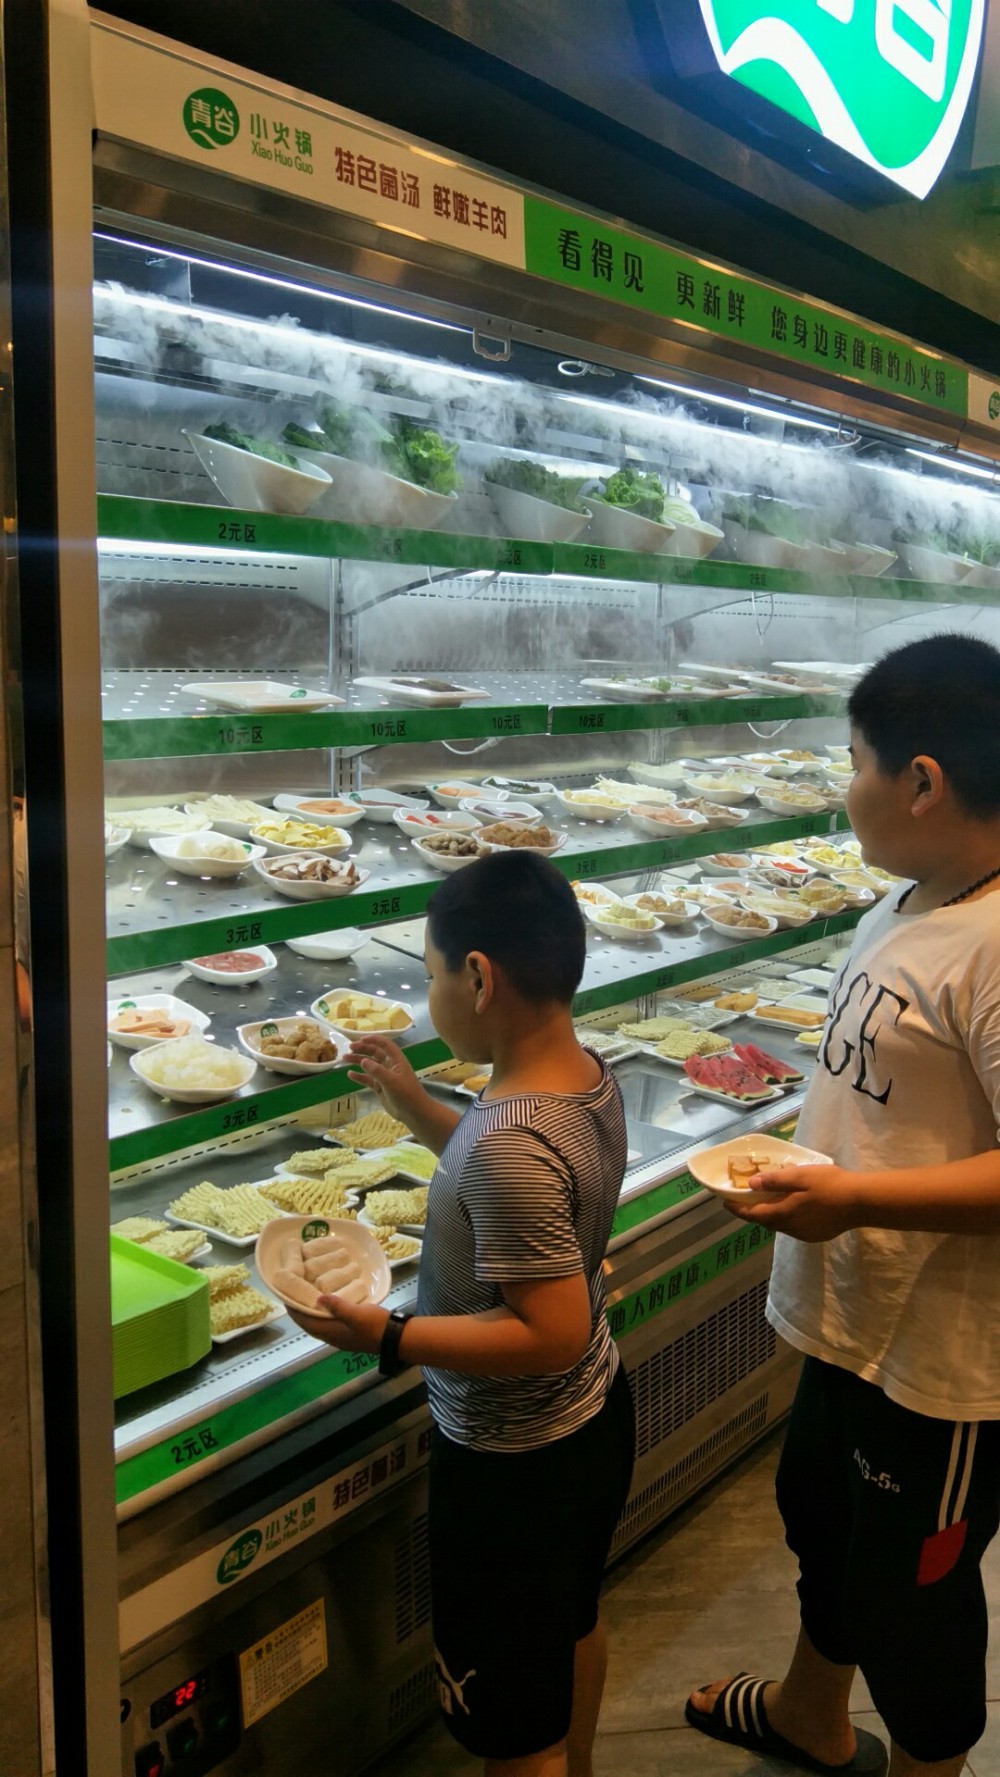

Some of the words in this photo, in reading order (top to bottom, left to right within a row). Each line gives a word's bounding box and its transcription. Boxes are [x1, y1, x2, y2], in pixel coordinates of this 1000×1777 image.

[190, 97, 236, 137] 青谷
[250, 113, 313, 158] 小火锅
[252, 141, 273, 161] Xiao
[274, 148, 294, 169] Huo
[294, 154, 314, 175] Guo
[335, 146, 420, 208] 特色菌汤
[433, 184, 507, 239] 鲜嫩羊肉
[558, 228, 644, 293] 看得见
[676, 270, 745, 326] 更新鲜
[771, 306, 946, 398] 您身边更健康的小火锅
[219, 522, 256, 543] 2元区
[584, 553, 606, 569] 2元区
[371, 720, 406, 737] 10元区
[493, 714, 522, 730] 10元区
[579, 713, 605, 728] 10元区
[218, 726, 264, 744] 10元区
[576, 859, 598, 874] 3元区
[372, 897, 401, 915] 3元区
[226, 922, 263, 943] 3元区
[222, 1104, 259, 1129] 3元区
[170, 1427, 220, 1465] 2元区
[332, 1443, 407, 1511] 特色菌汤
[265, 1496, 316, 1541] 小火锅
